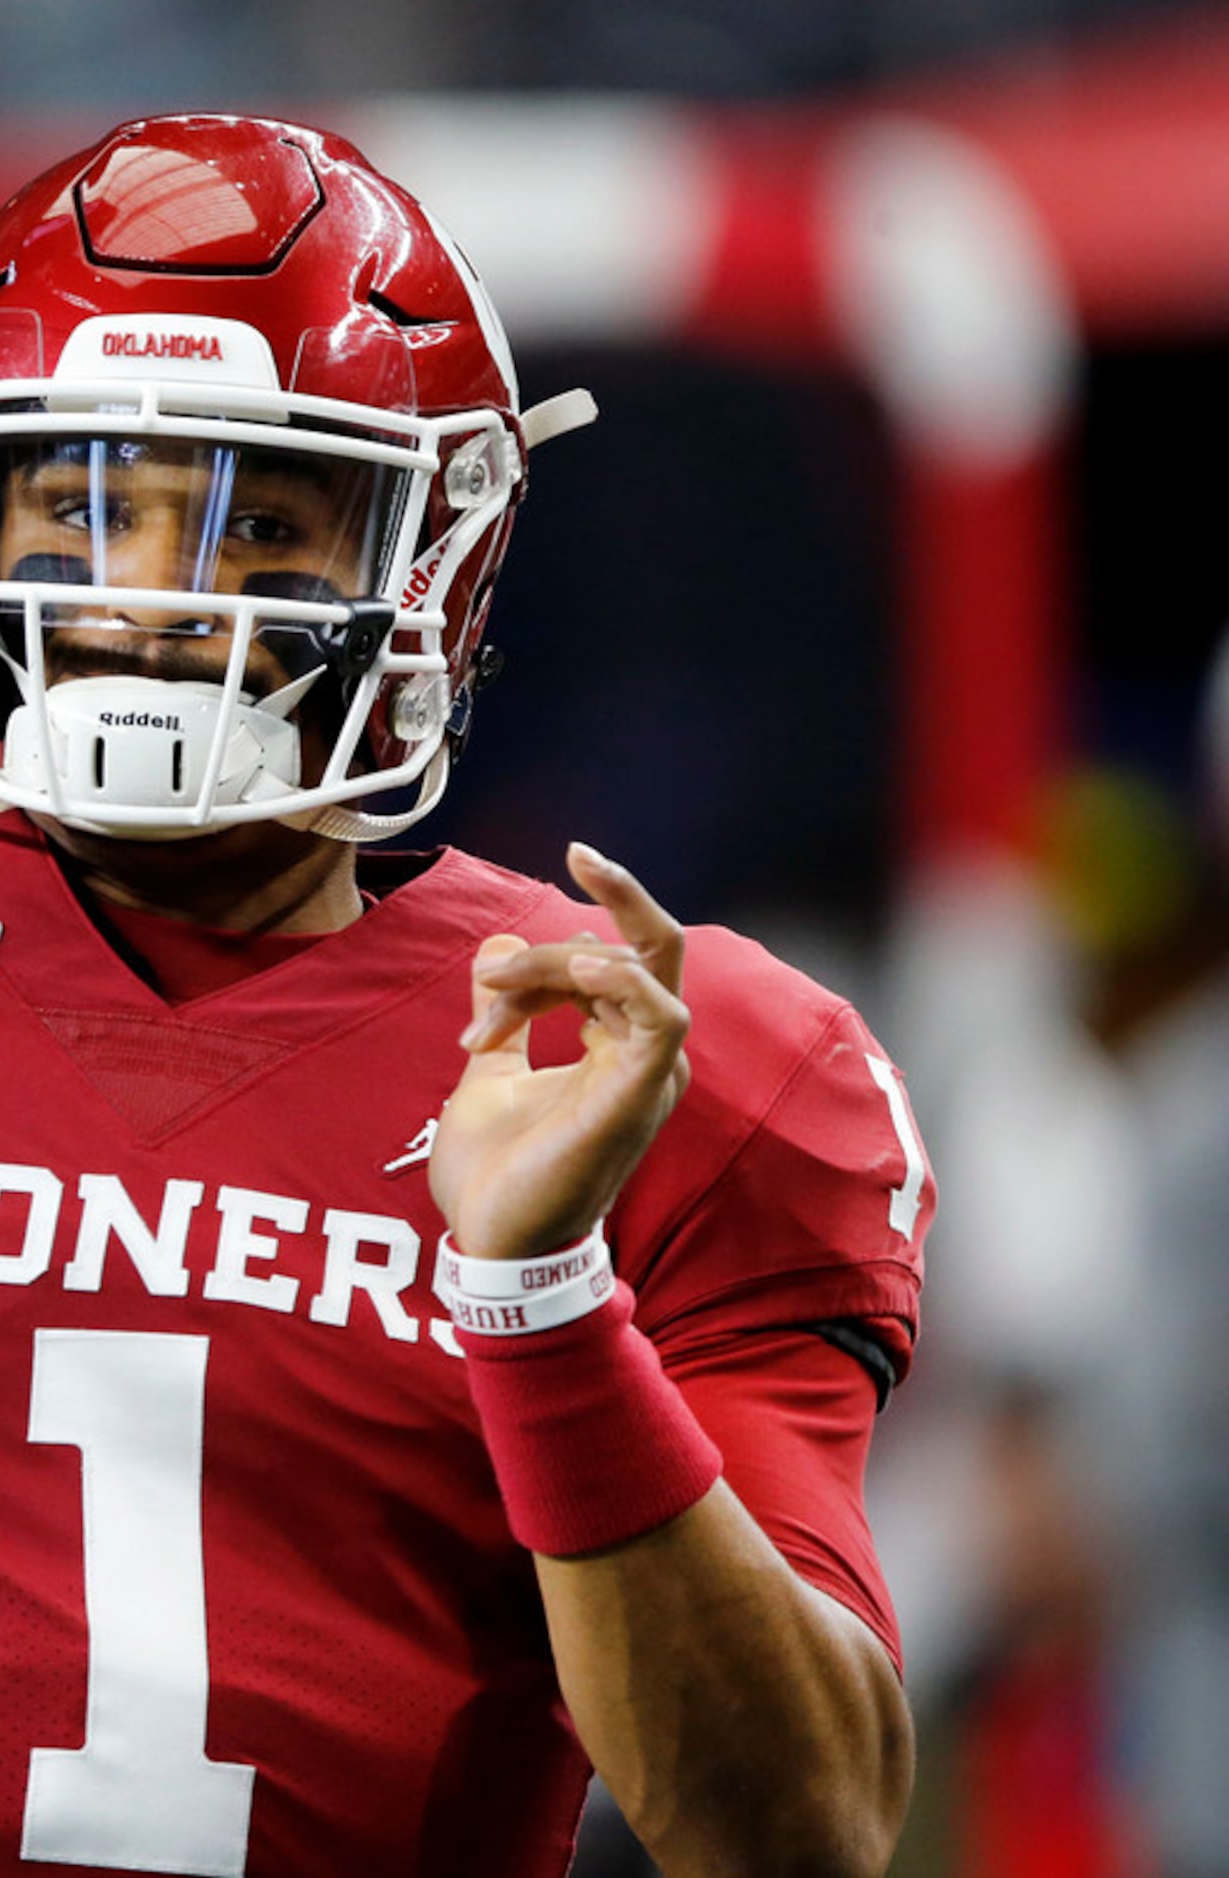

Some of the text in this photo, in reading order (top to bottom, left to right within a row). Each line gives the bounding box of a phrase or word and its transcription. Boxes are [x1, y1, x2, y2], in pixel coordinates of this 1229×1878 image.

[102, 331, 224, 361] OKLAHOMA
[98, 710, 179, 731] Riddell
[864, 1053, 925, 1242] 1
[520, 1248, 595, 1291] NTAMED
[20, 1328, 256, 1878] 1
